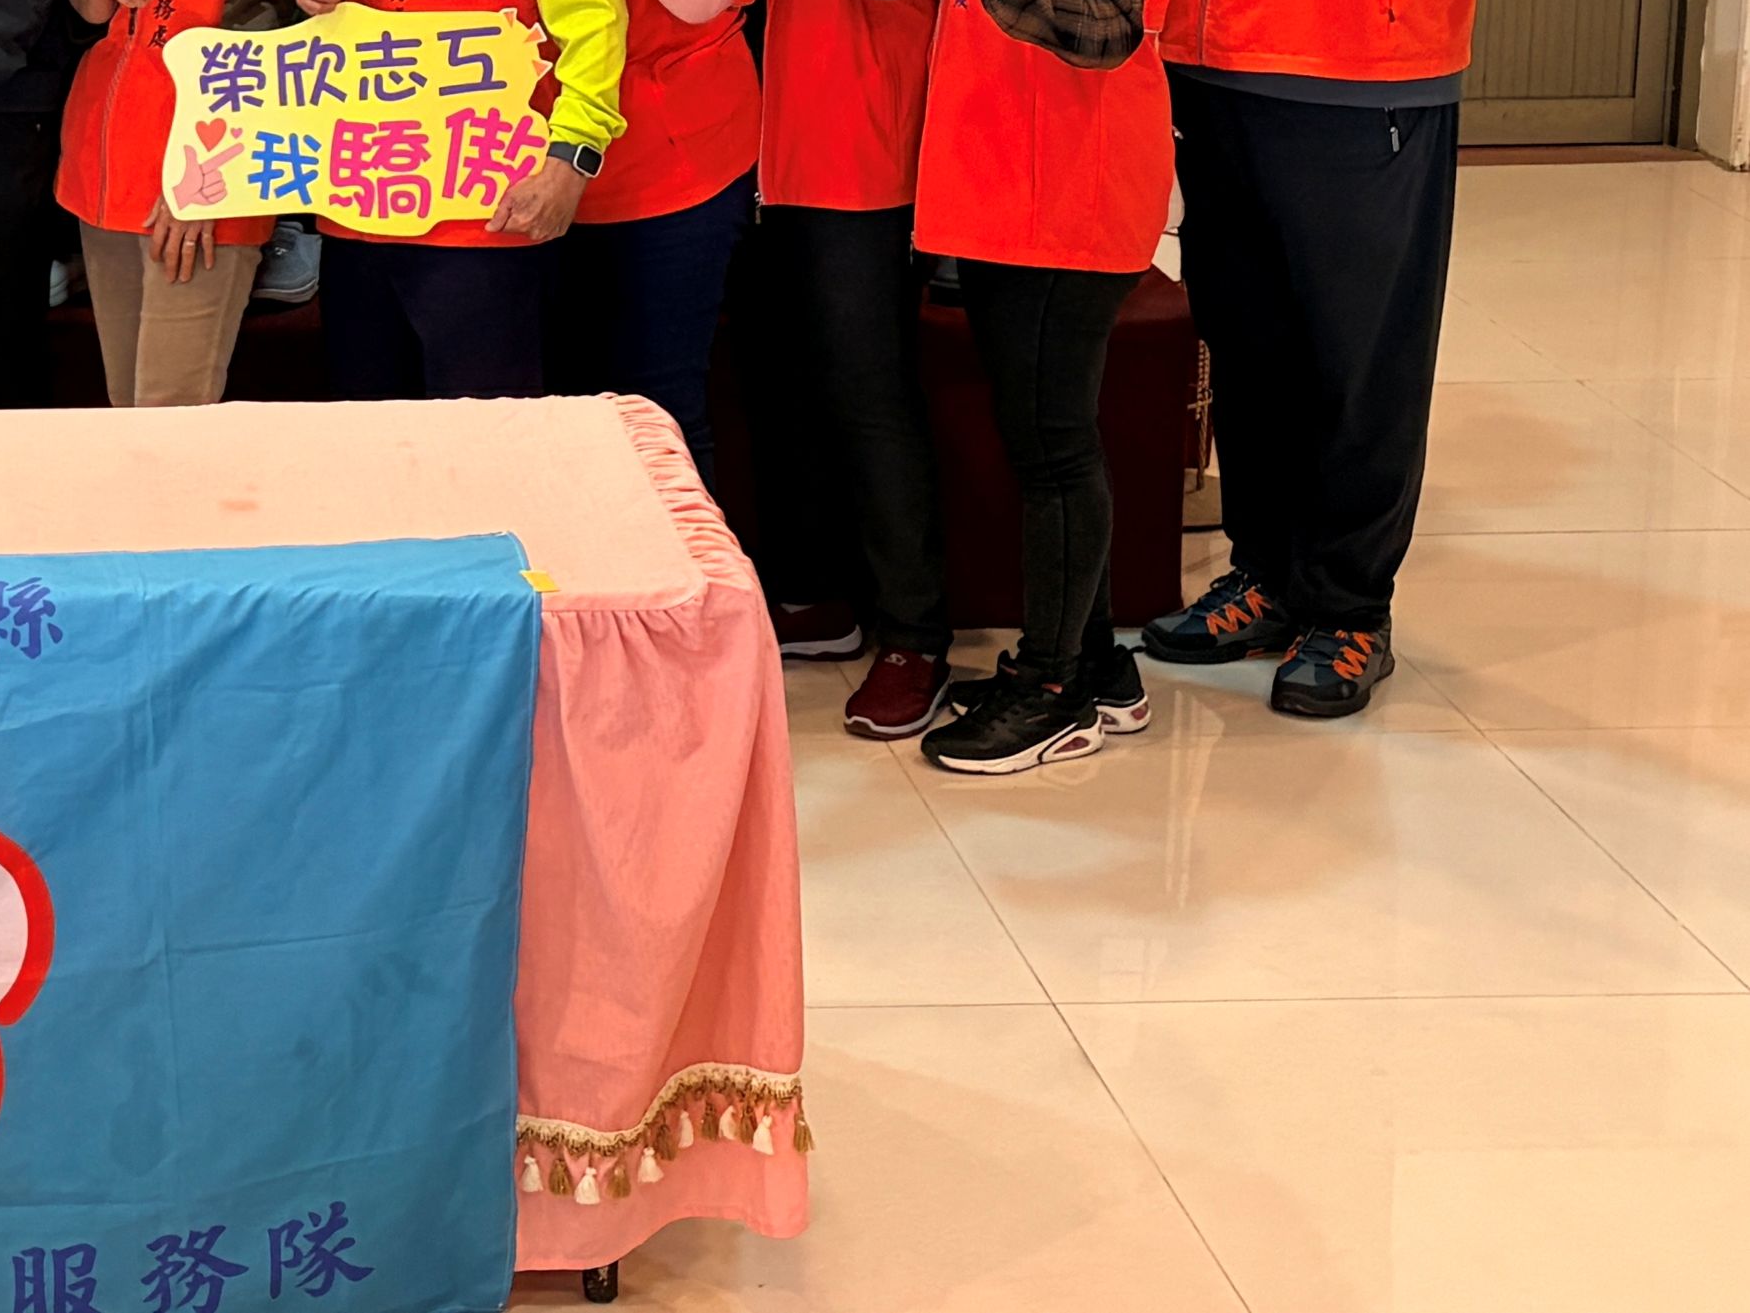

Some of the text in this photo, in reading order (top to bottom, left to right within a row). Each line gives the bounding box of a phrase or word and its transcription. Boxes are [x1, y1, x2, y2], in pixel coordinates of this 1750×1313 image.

[199, 26, 508, 113] 榮欣志工
[247, 107, 548, 219] 我驕傲
